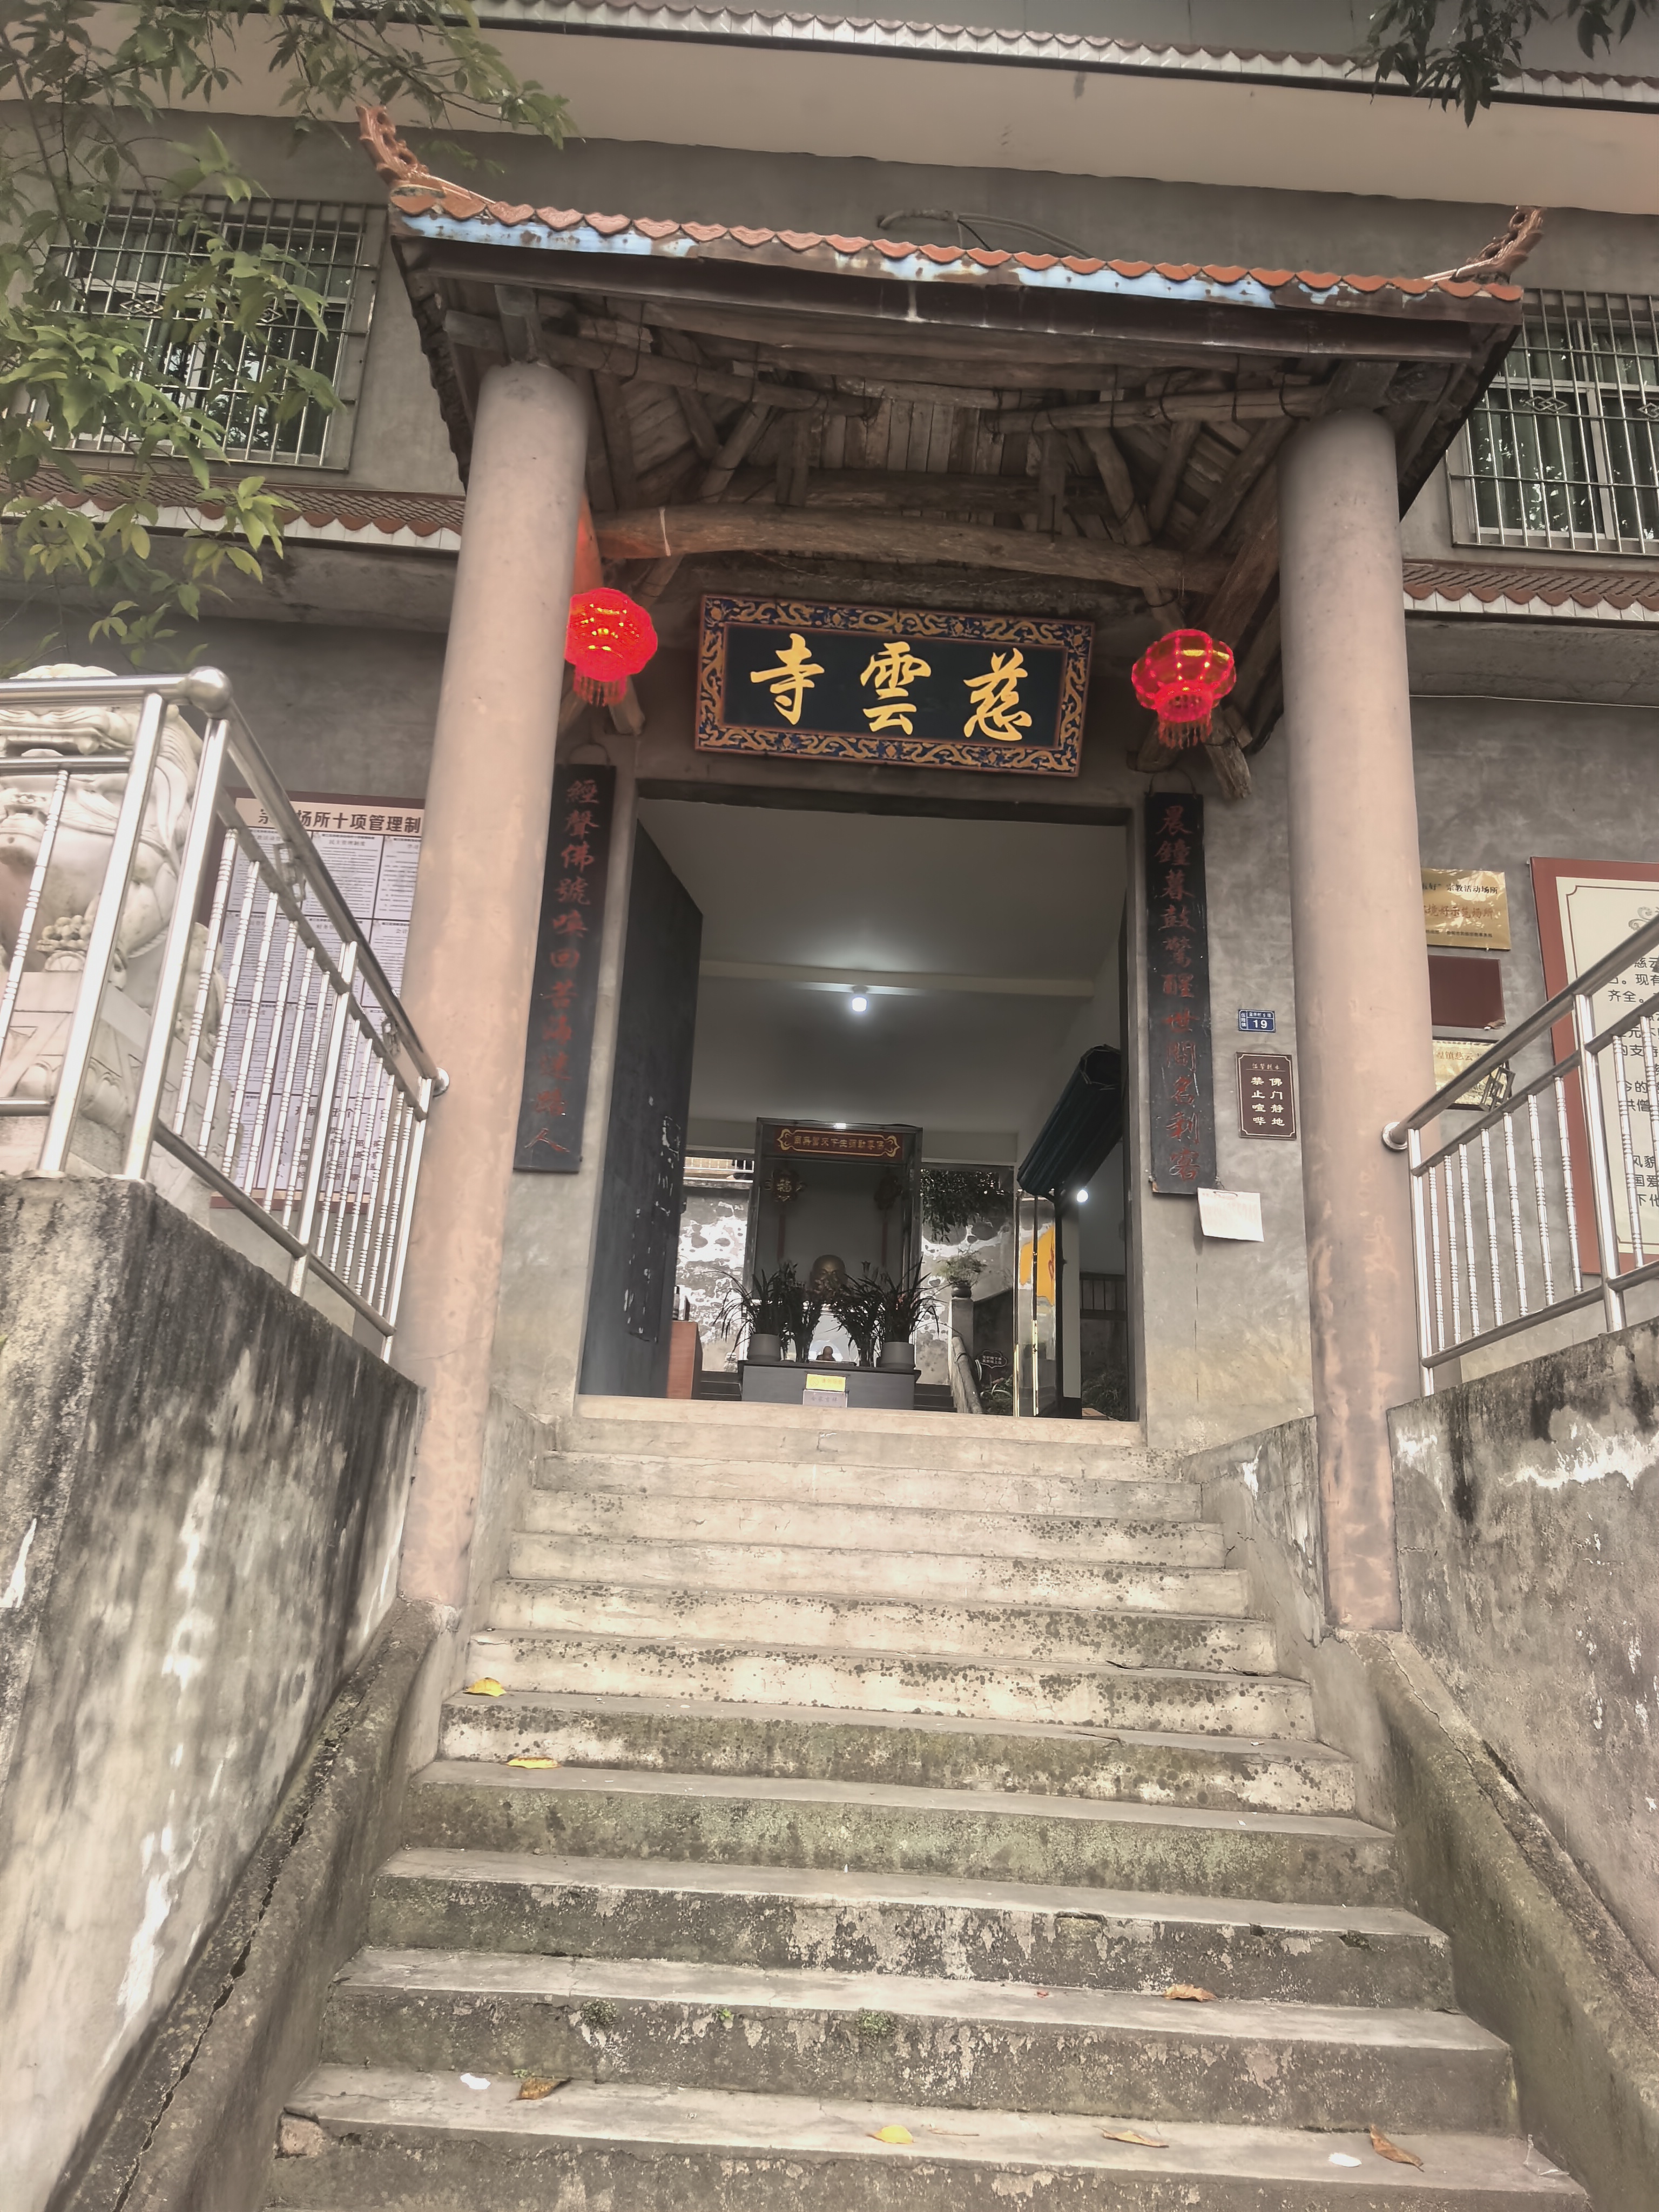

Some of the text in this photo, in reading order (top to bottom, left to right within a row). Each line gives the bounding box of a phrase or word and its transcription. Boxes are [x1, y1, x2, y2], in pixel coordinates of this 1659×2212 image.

[1253, 1020, 1267, 1029] 19
[1251, 1076, 1266, 1125] 禁止喧哗
[1269, 1078, 1285, 1127] 佛门静地
